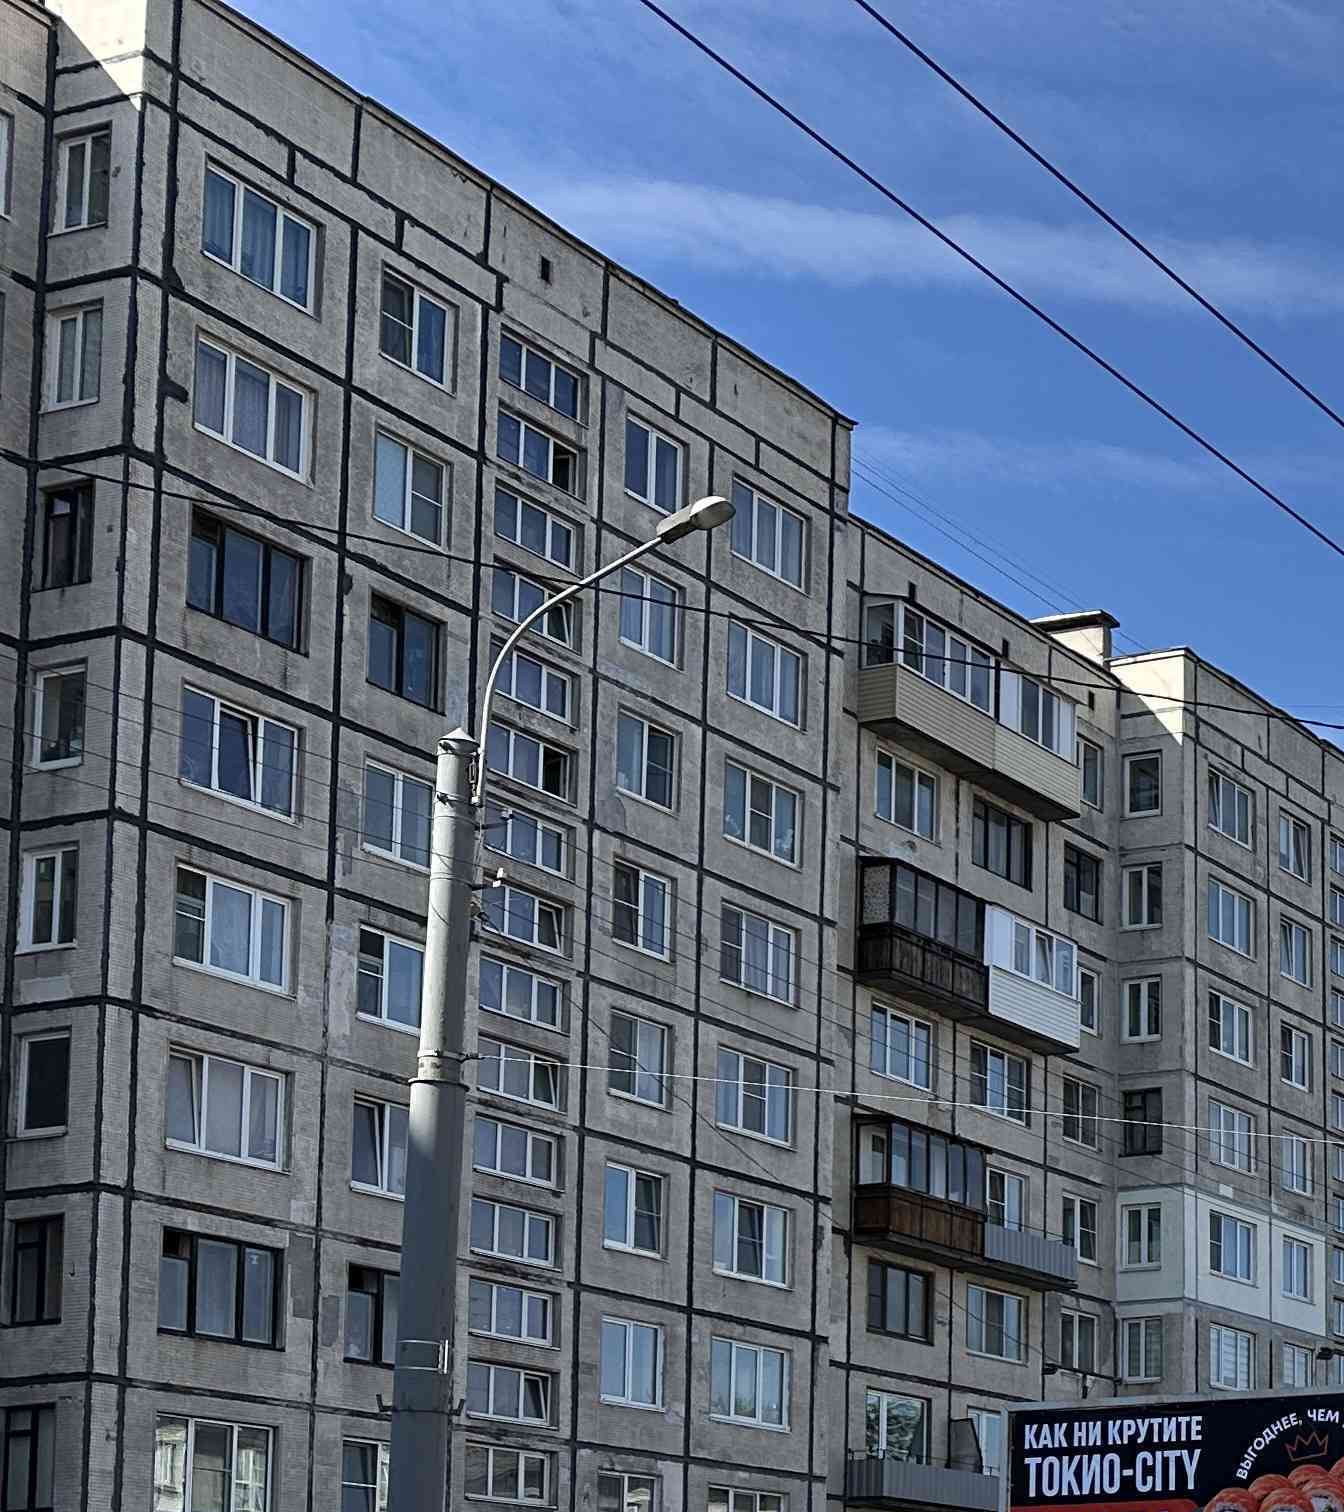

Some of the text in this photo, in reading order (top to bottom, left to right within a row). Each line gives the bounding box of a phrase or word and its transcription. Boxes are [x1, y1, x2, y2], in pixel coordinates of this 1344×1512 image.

[1024, 1415, 1203, 1450] КАК НИ КРУТИТЕ
[1235, 1412, 1303, 1480] ВЫГОДНЕЕ,
[1307, 1408, 1340, 1424] ЧЕМ
[1023, 1448, 1202, 1498] ТОКИО-CITY
